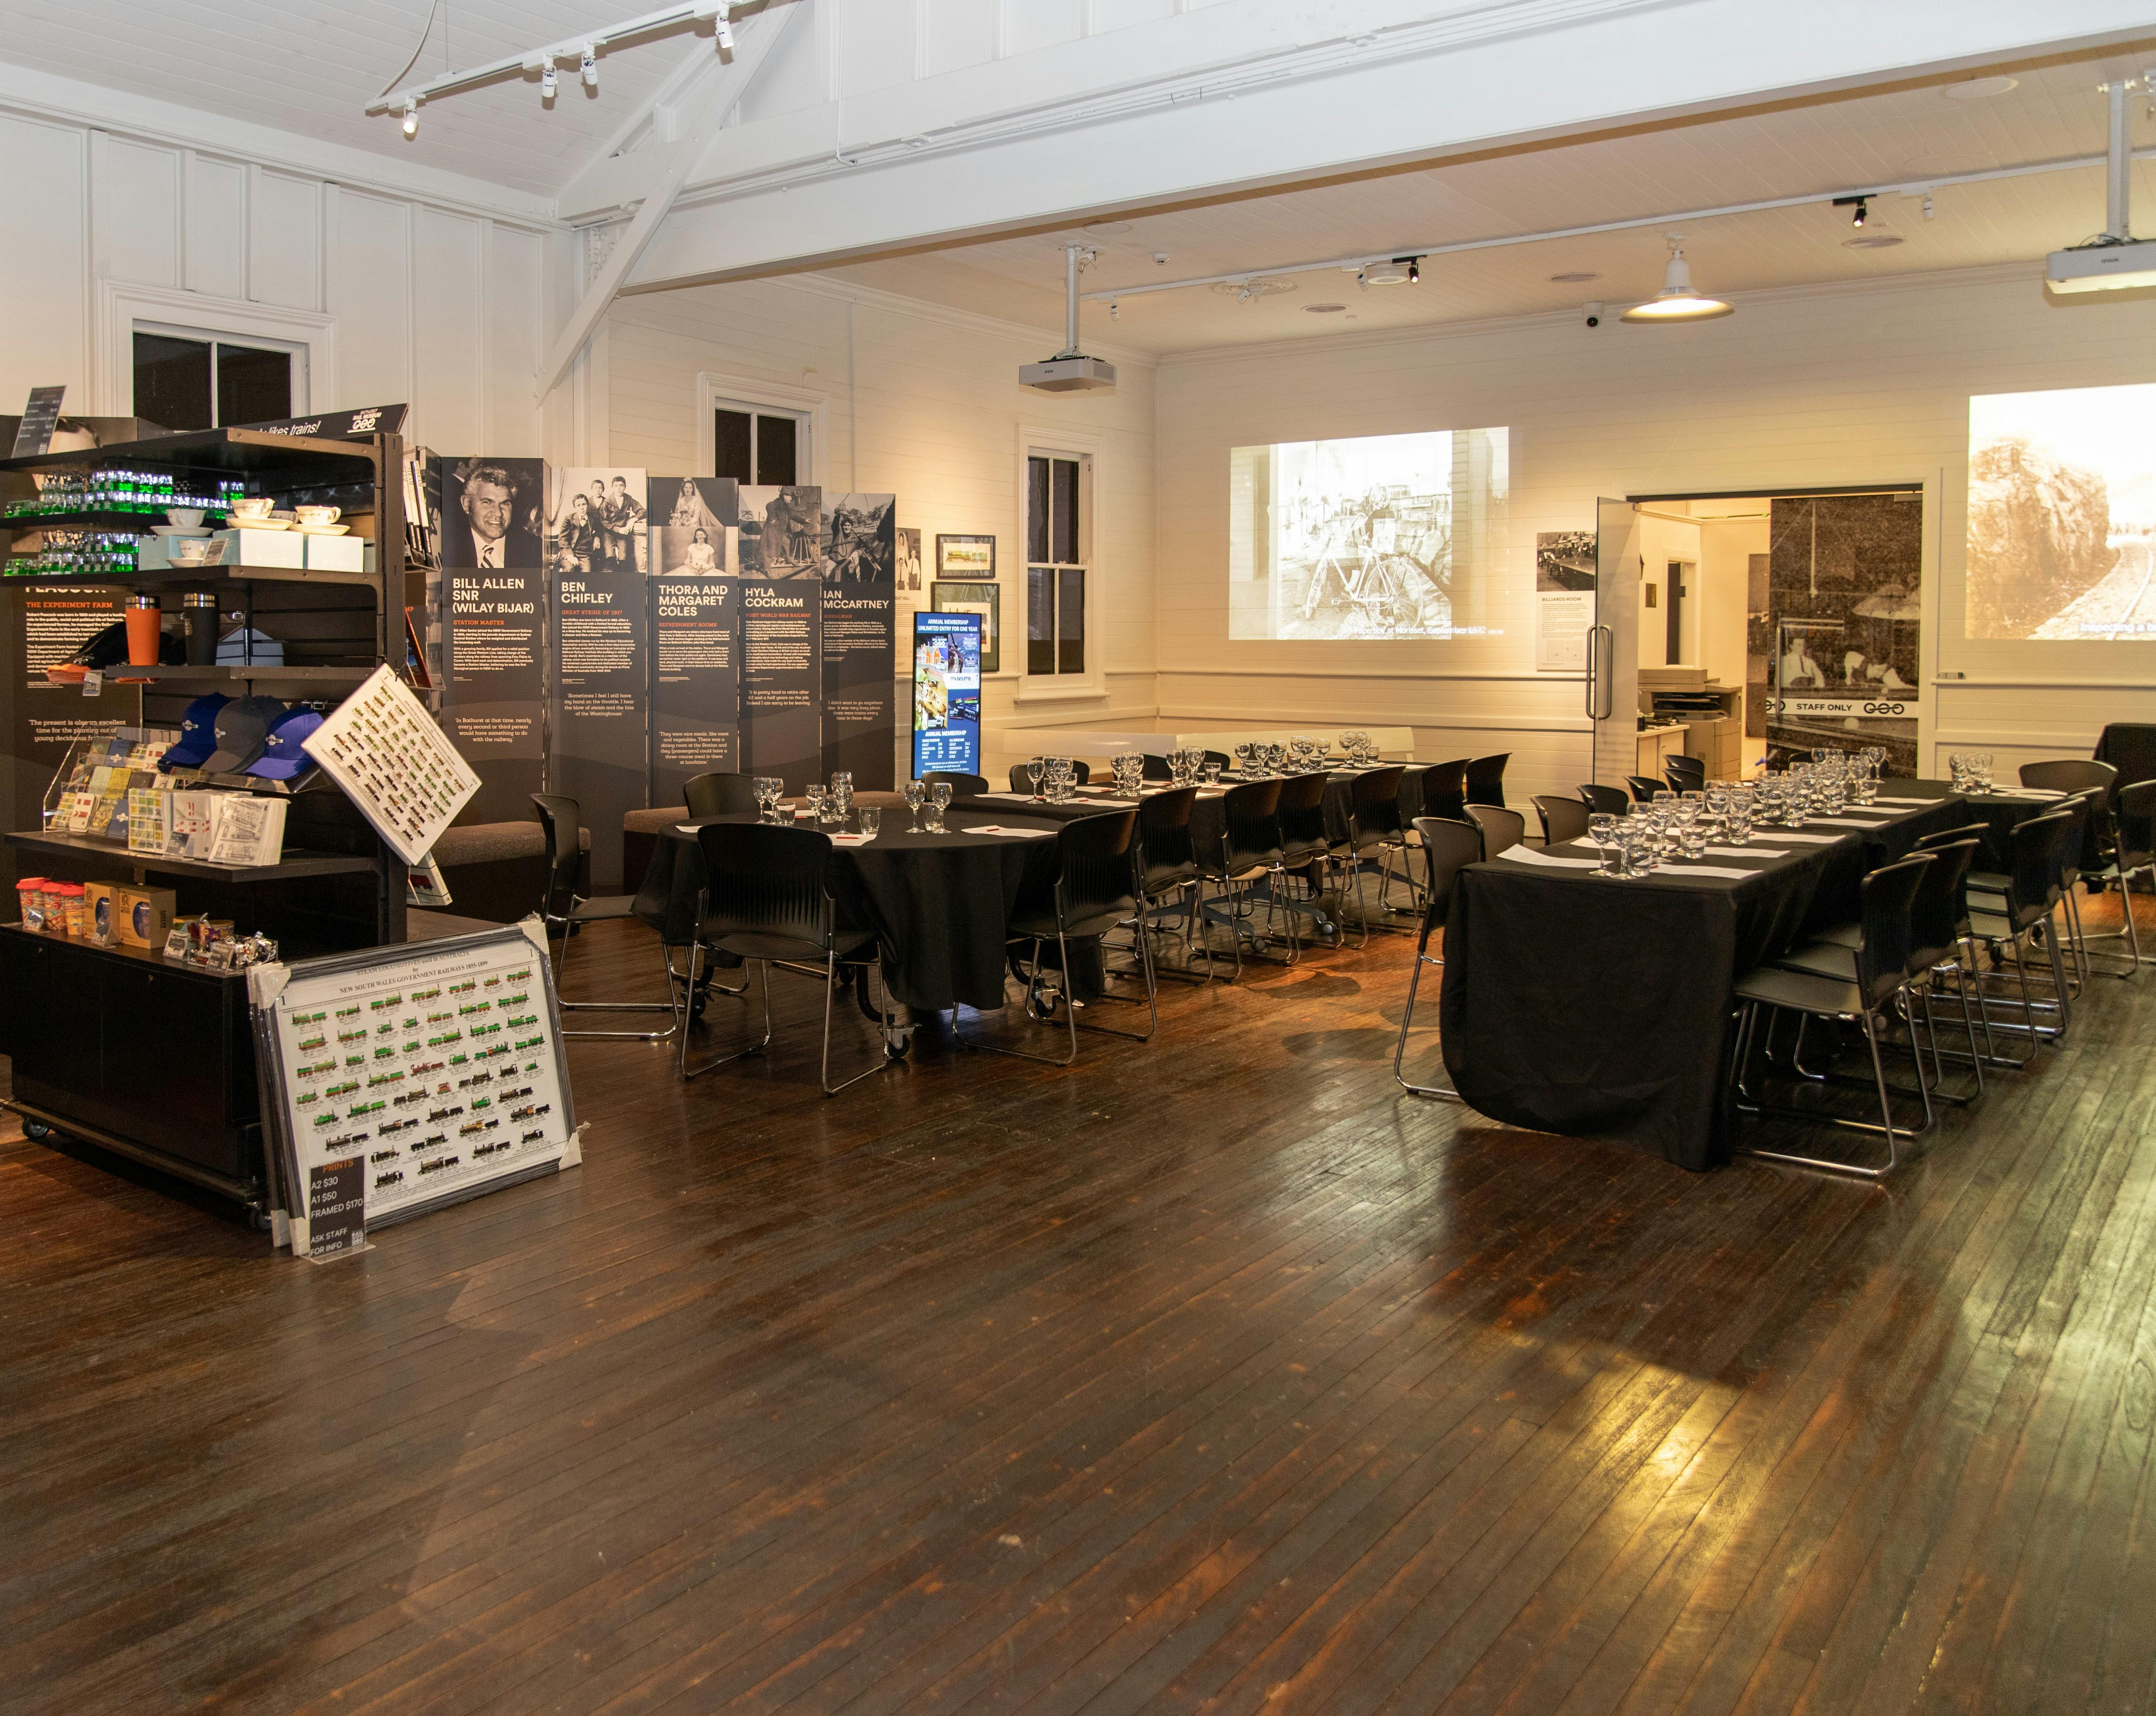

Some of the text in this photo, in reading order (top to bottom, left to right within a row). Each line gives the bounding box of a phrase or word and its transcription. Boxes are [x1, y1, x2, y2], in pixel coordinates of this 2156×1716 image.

[268, 420, 321, 436] likes trains!
[453, 578, 524, 589] BILL ALLEN
[562, 582, 585, 592] BEN
[659, 585, 728, 594] THORA AND
[746, 588, 775, 596] HYLA
[453, 590, 478, 601] SNR
[561, 593, 613, 603] CHIFLEY
[659, 596, 724, 605] MARGARET
[453, 602, 534, 614] (WILAY BIJAR)
[745, 598, 803, 607] COCKRAM
[824, 600, 889, 608] MCCARTNEY
[659, 607, 697, 616] COLES
[1355, 627, 1385, 637] Paperboy
[2080, 622, 2135, 634] Inspecting
[357, 966, 378, 976] STEAM
[379, 959, 421, 972] LOCOMOTIVES
[438, 950, 469, 960] AUSTRALIA
[340, 960, 488, 994] NEW SOUTH WALES GOVERNMENT RAILWAYS 1855-1899
[281, 995, 286, 1005] 1
[323, 1158, 354, 1173] PRINTS
[311, 1176, 338, 1190] A2 $30
[311, 1191, 337, 1205] A1 $50
[311, 1198, 363, 1219] FRAMED $170
[311, 1227, 348, 1244] ASK STAFF
[311, 1241, 342, 1255] FOR INFO
